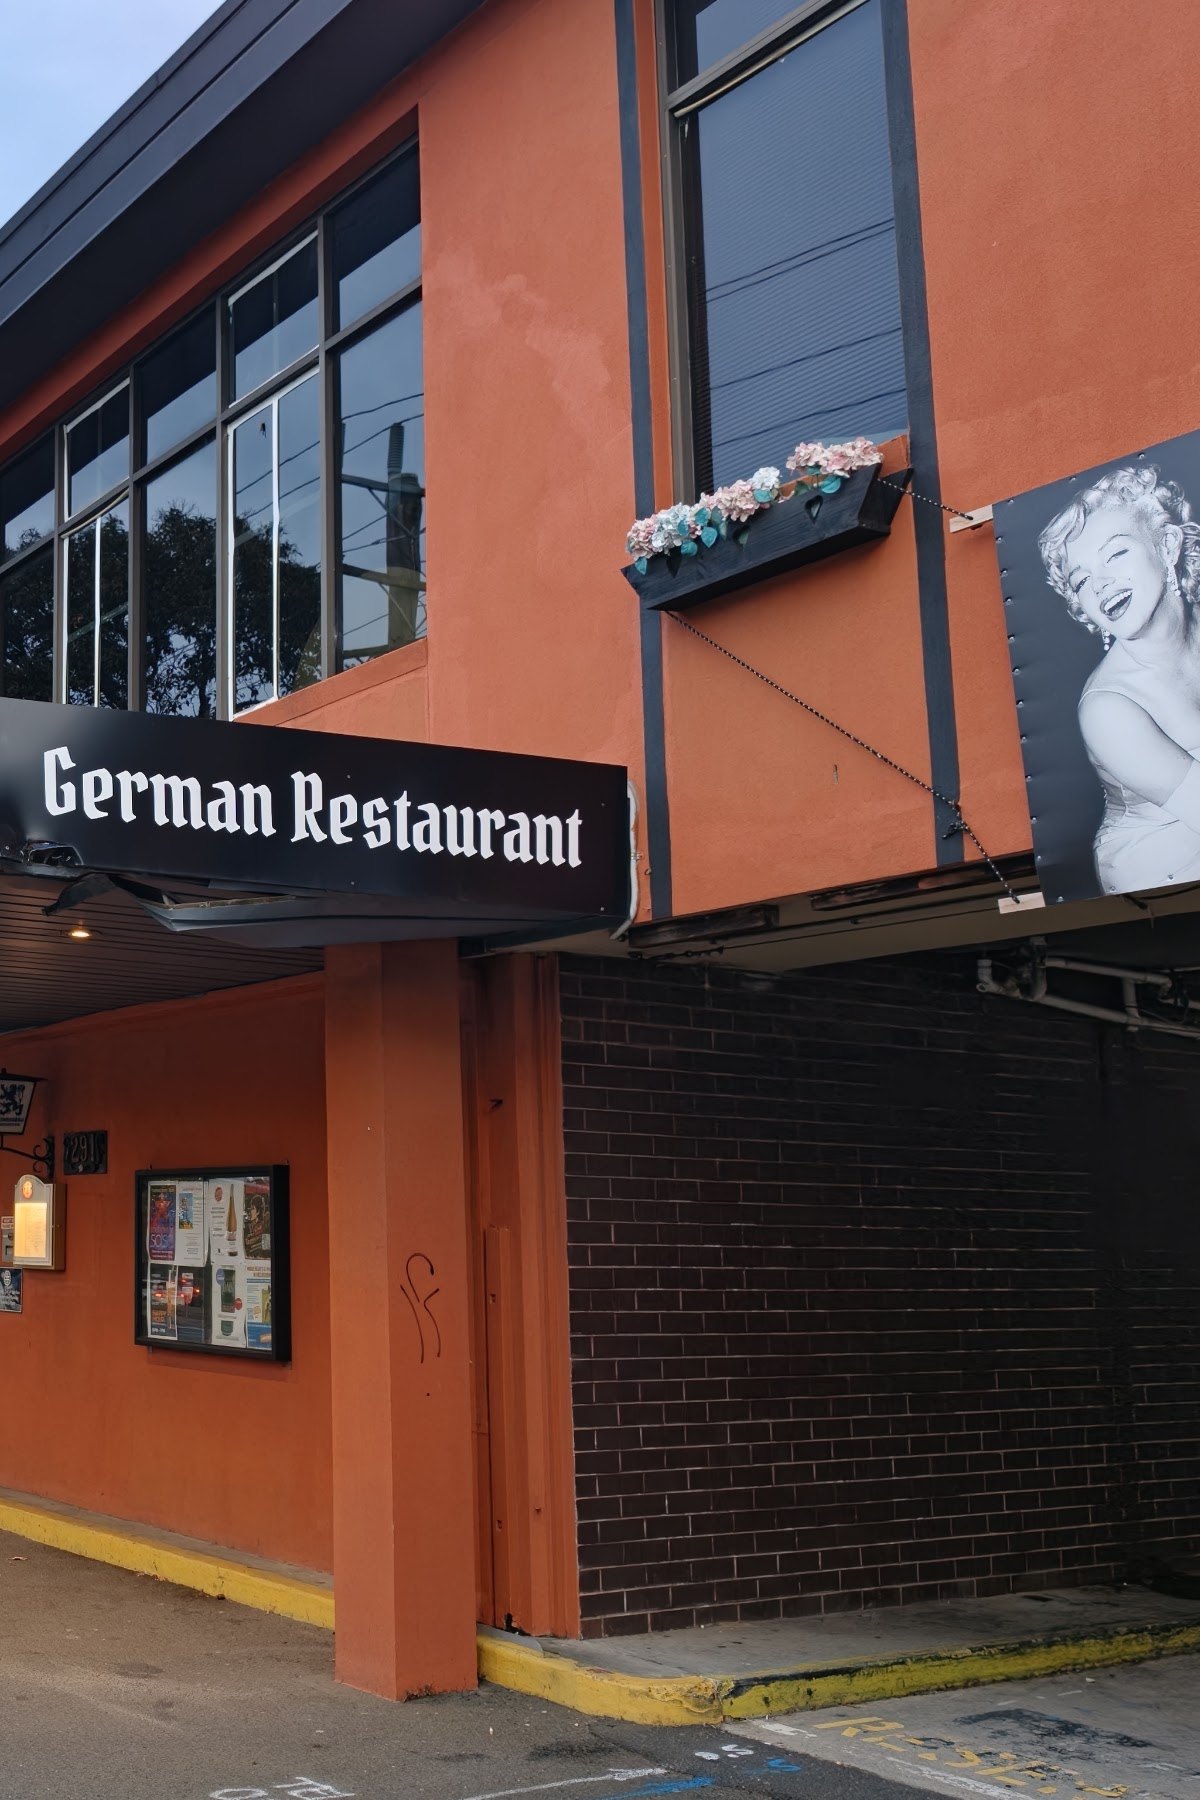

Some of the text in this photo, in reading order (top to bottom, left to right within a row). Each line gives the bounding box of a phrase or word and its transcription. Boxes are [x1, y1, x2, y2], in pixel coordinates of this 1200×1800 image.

[43, 746, 583, 869] German Restaurant
[70, 1134, 96, 1163] 291
